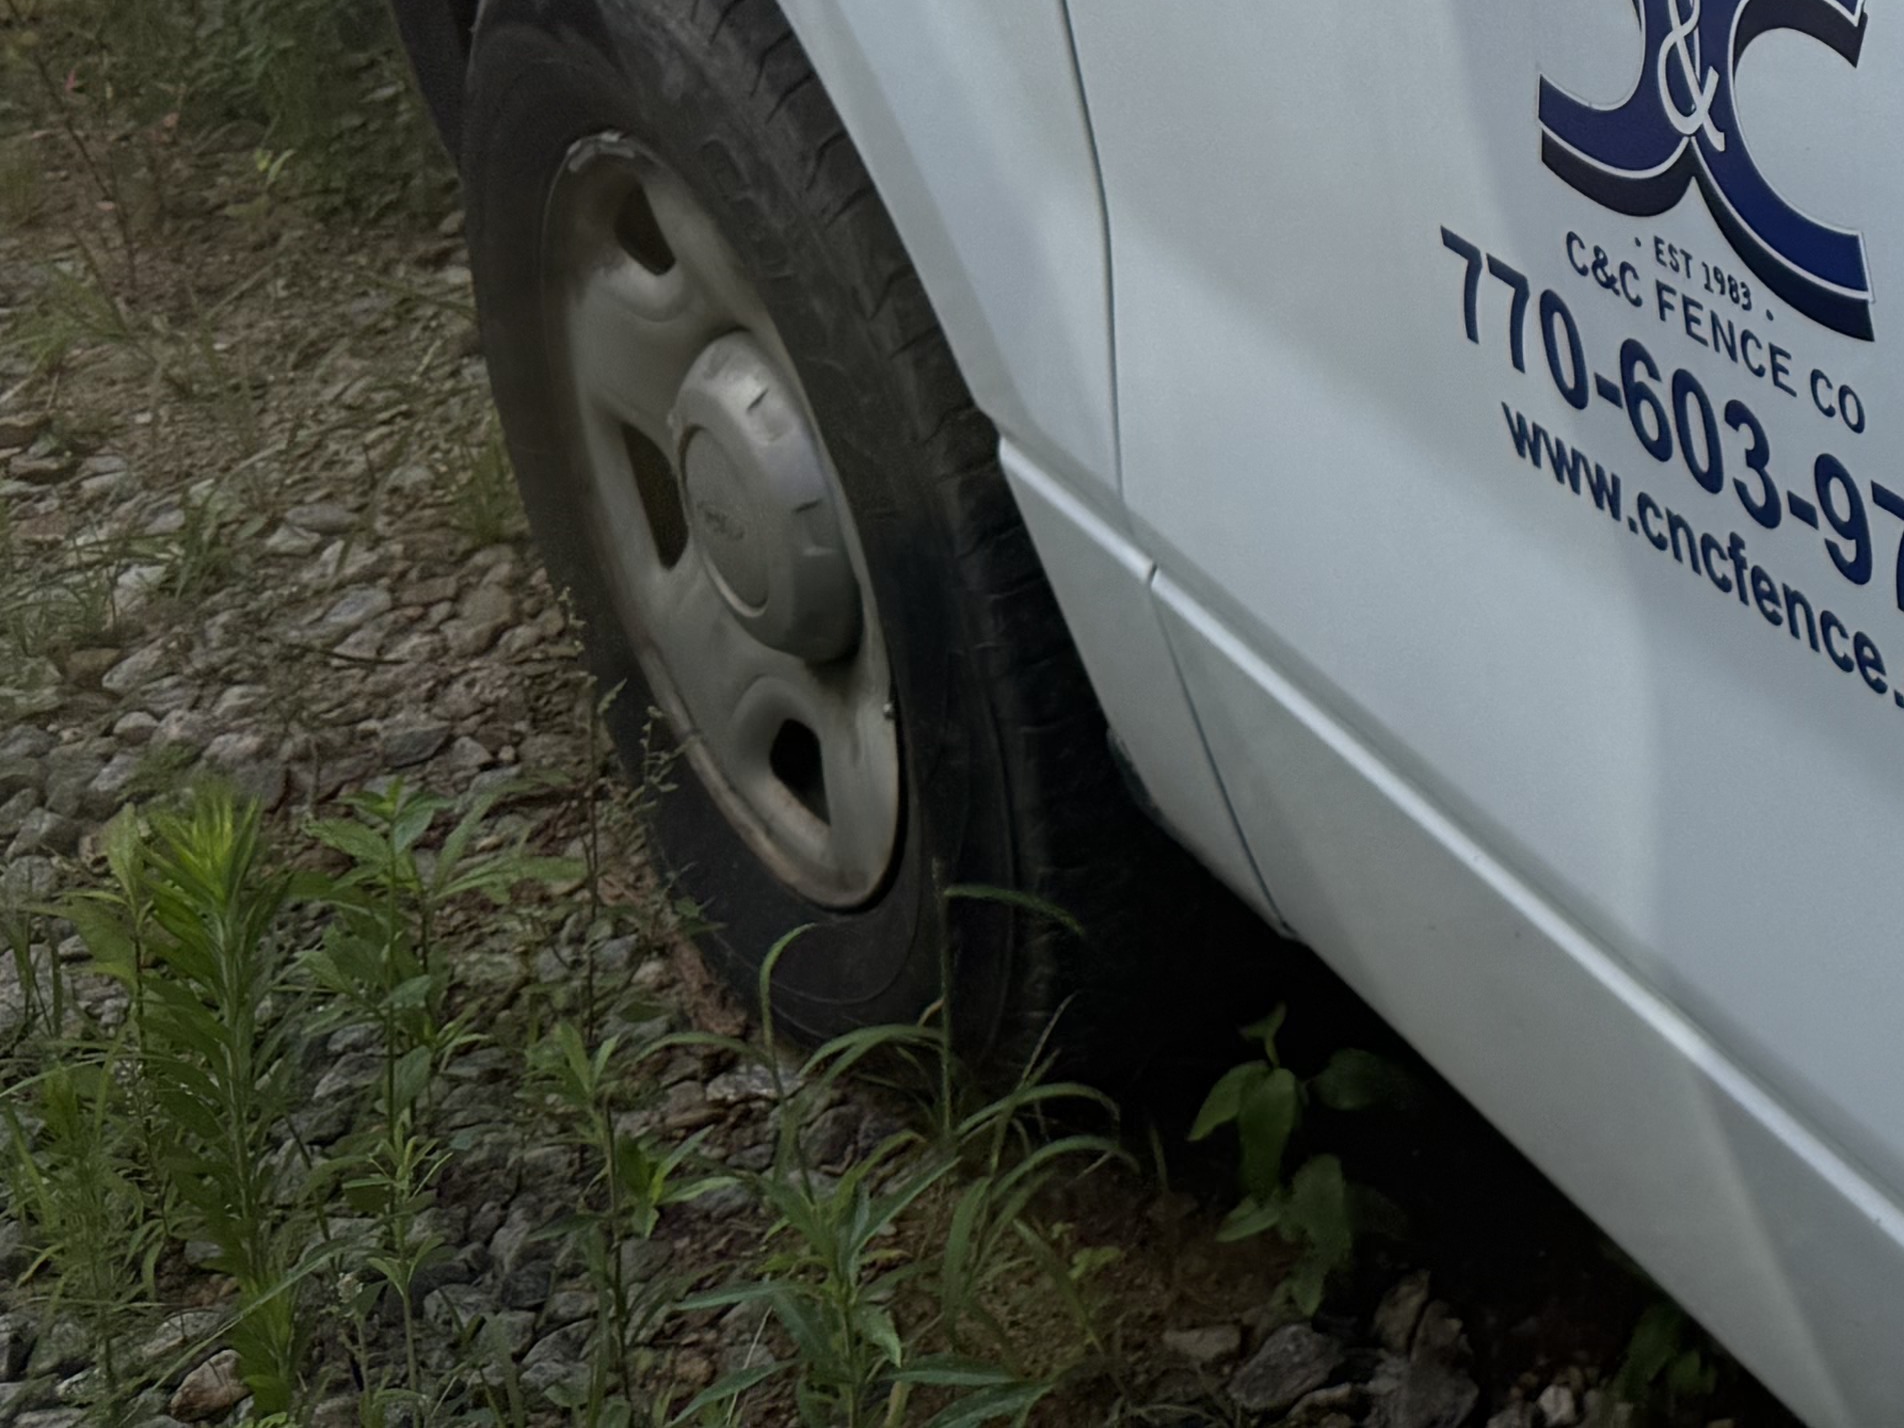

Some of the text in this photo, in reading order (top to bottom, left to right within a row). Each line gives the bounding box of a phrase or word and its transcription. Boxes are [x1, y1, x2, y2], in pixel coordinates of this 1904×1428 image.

[1566, 230, 1866, 435] C&C FENCE CO
[1653, 235, 1753, 311] EST 1983
